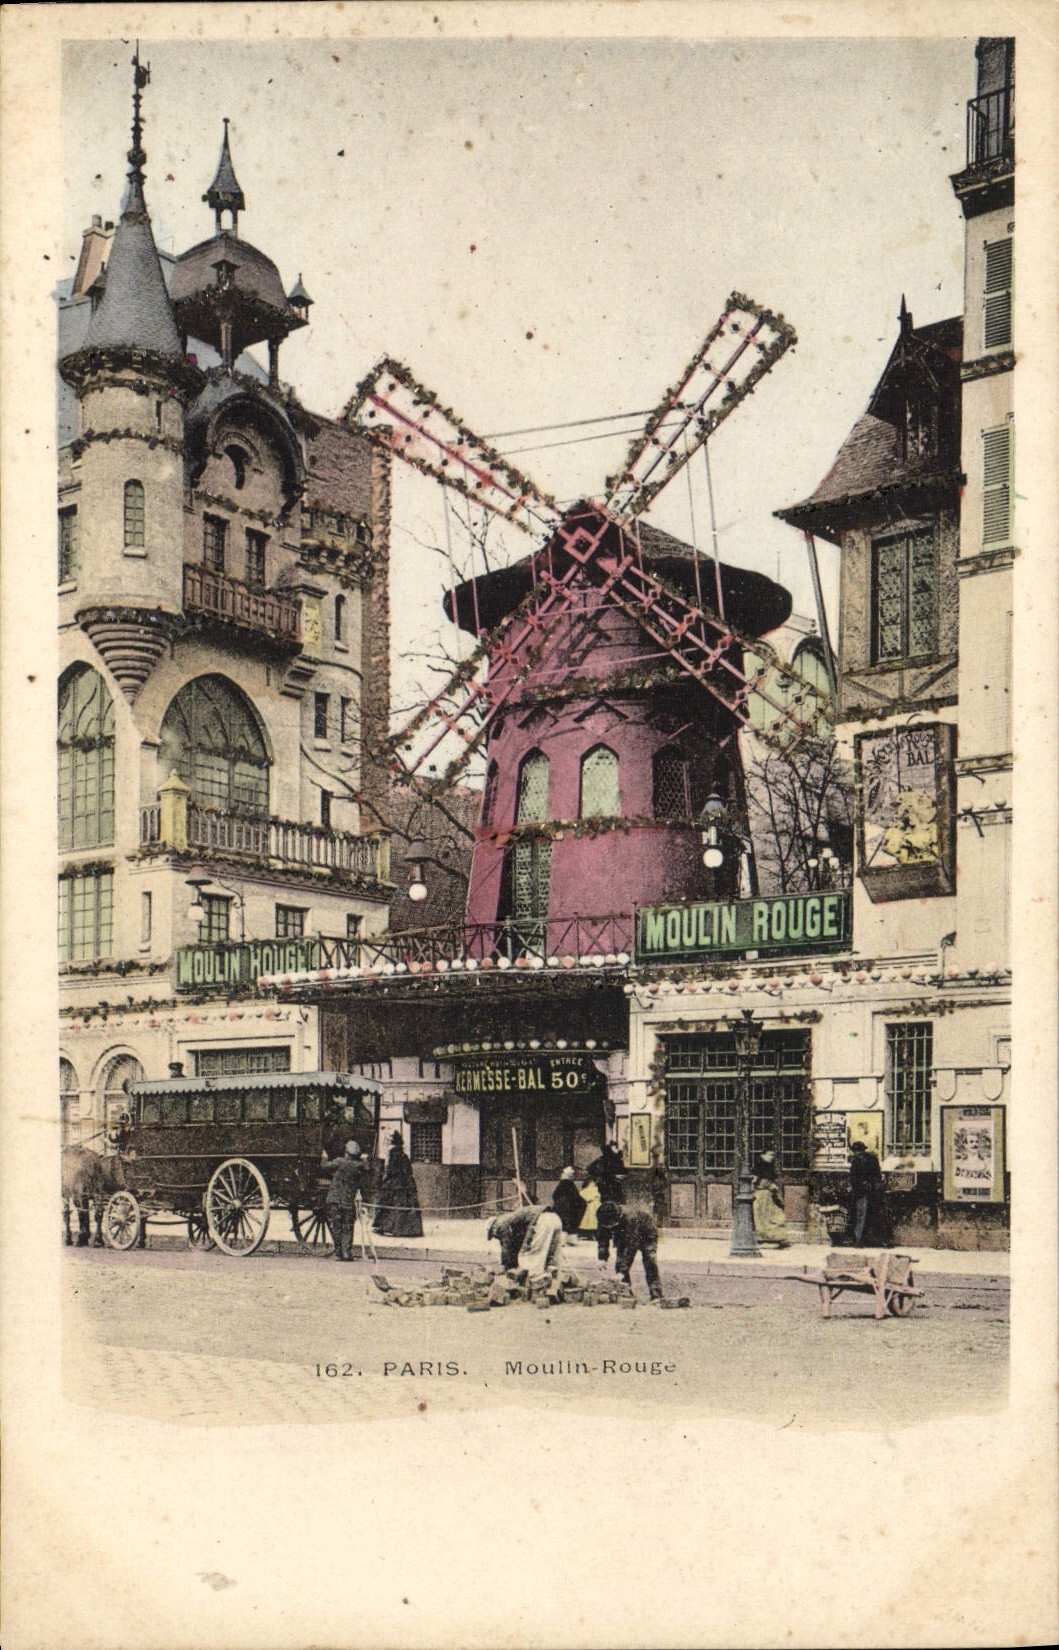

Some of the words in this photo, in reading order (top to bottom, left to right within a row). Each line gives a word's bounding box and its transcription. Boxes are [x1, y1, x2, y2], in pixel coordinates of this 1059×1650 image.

[906, 750, 934, 767] BAL
[645, 904, 737, 950] MOULIN
[752, 896, 839, 942] ROUGE
[178, 949, 241, 984] MOULIN
[250, 942, 307, 979] ROUGE
[455, 1067, 546, 1092] KERMESSE-BAL
